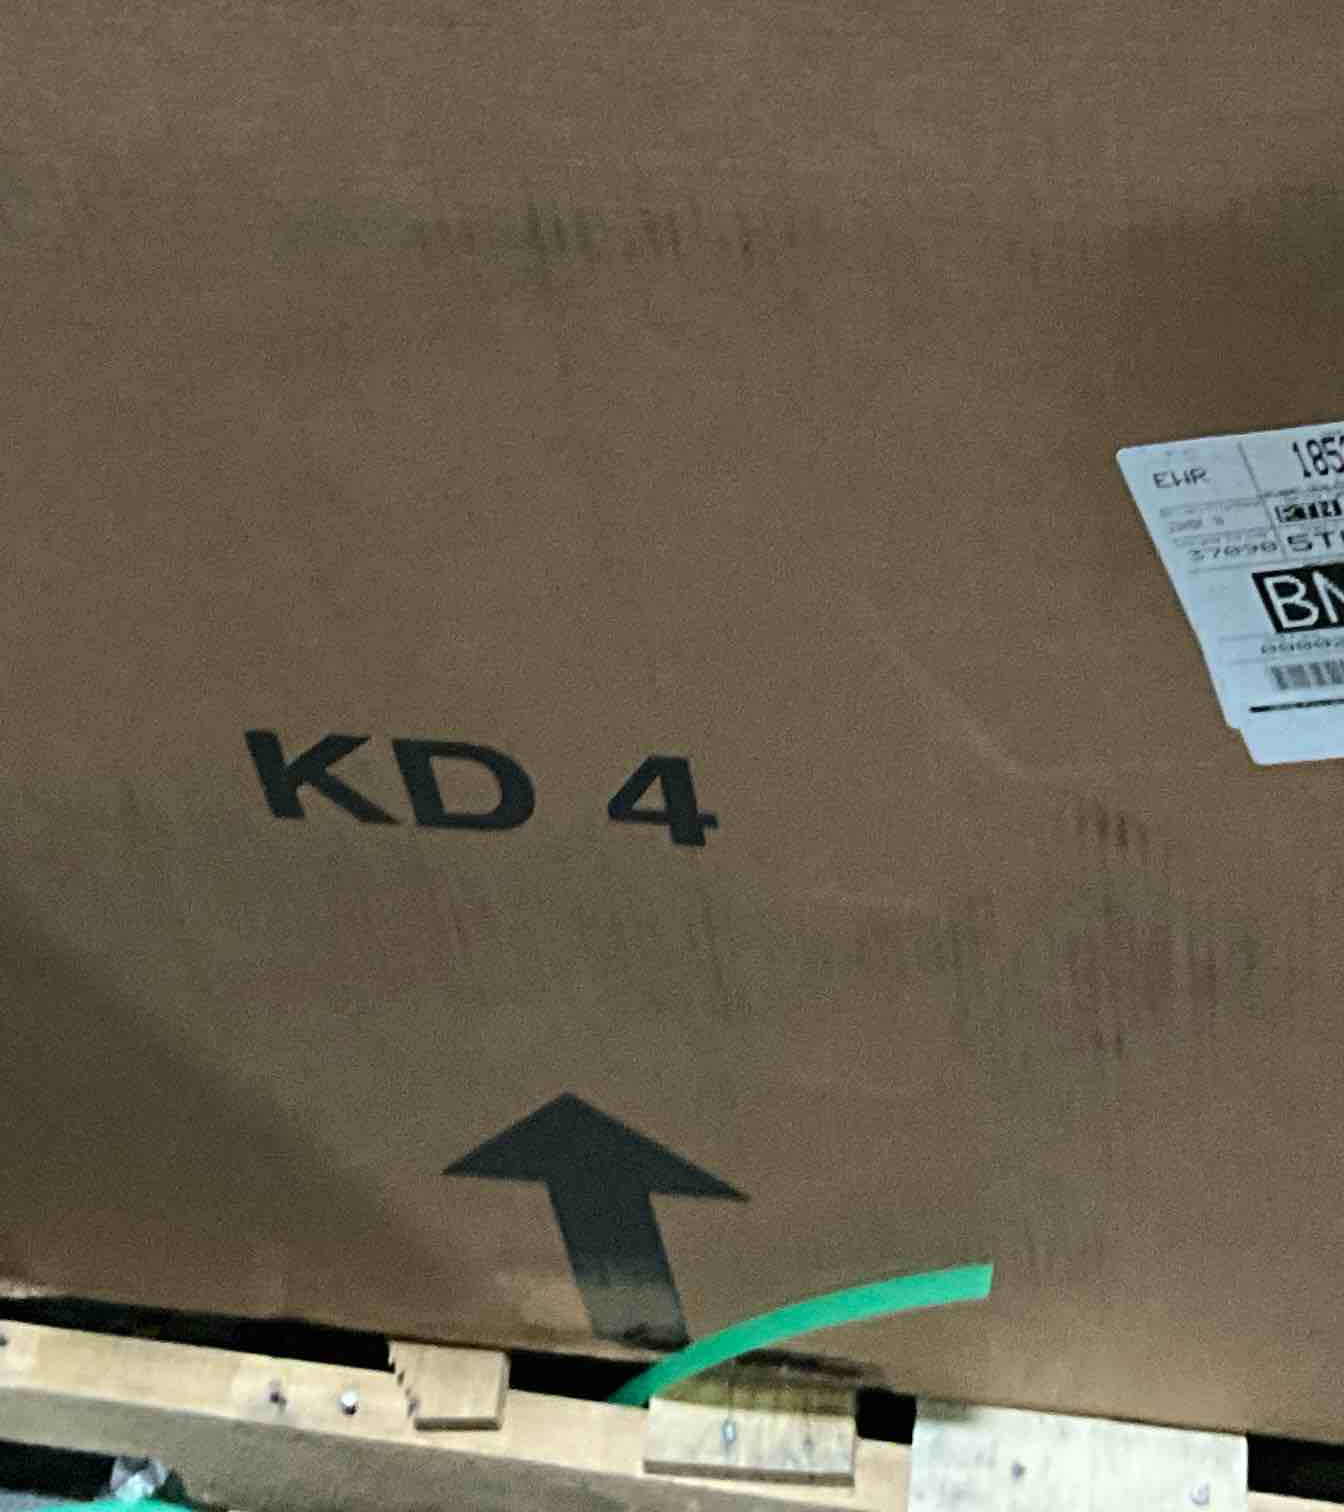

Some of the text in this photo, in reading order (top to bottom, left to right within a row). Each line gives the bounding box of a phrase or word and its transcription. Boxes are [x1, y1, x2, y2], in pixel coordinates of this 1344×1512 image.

[1152, 467, 1209, 489] EWR
[244, 729, 719, 848] KD 4
